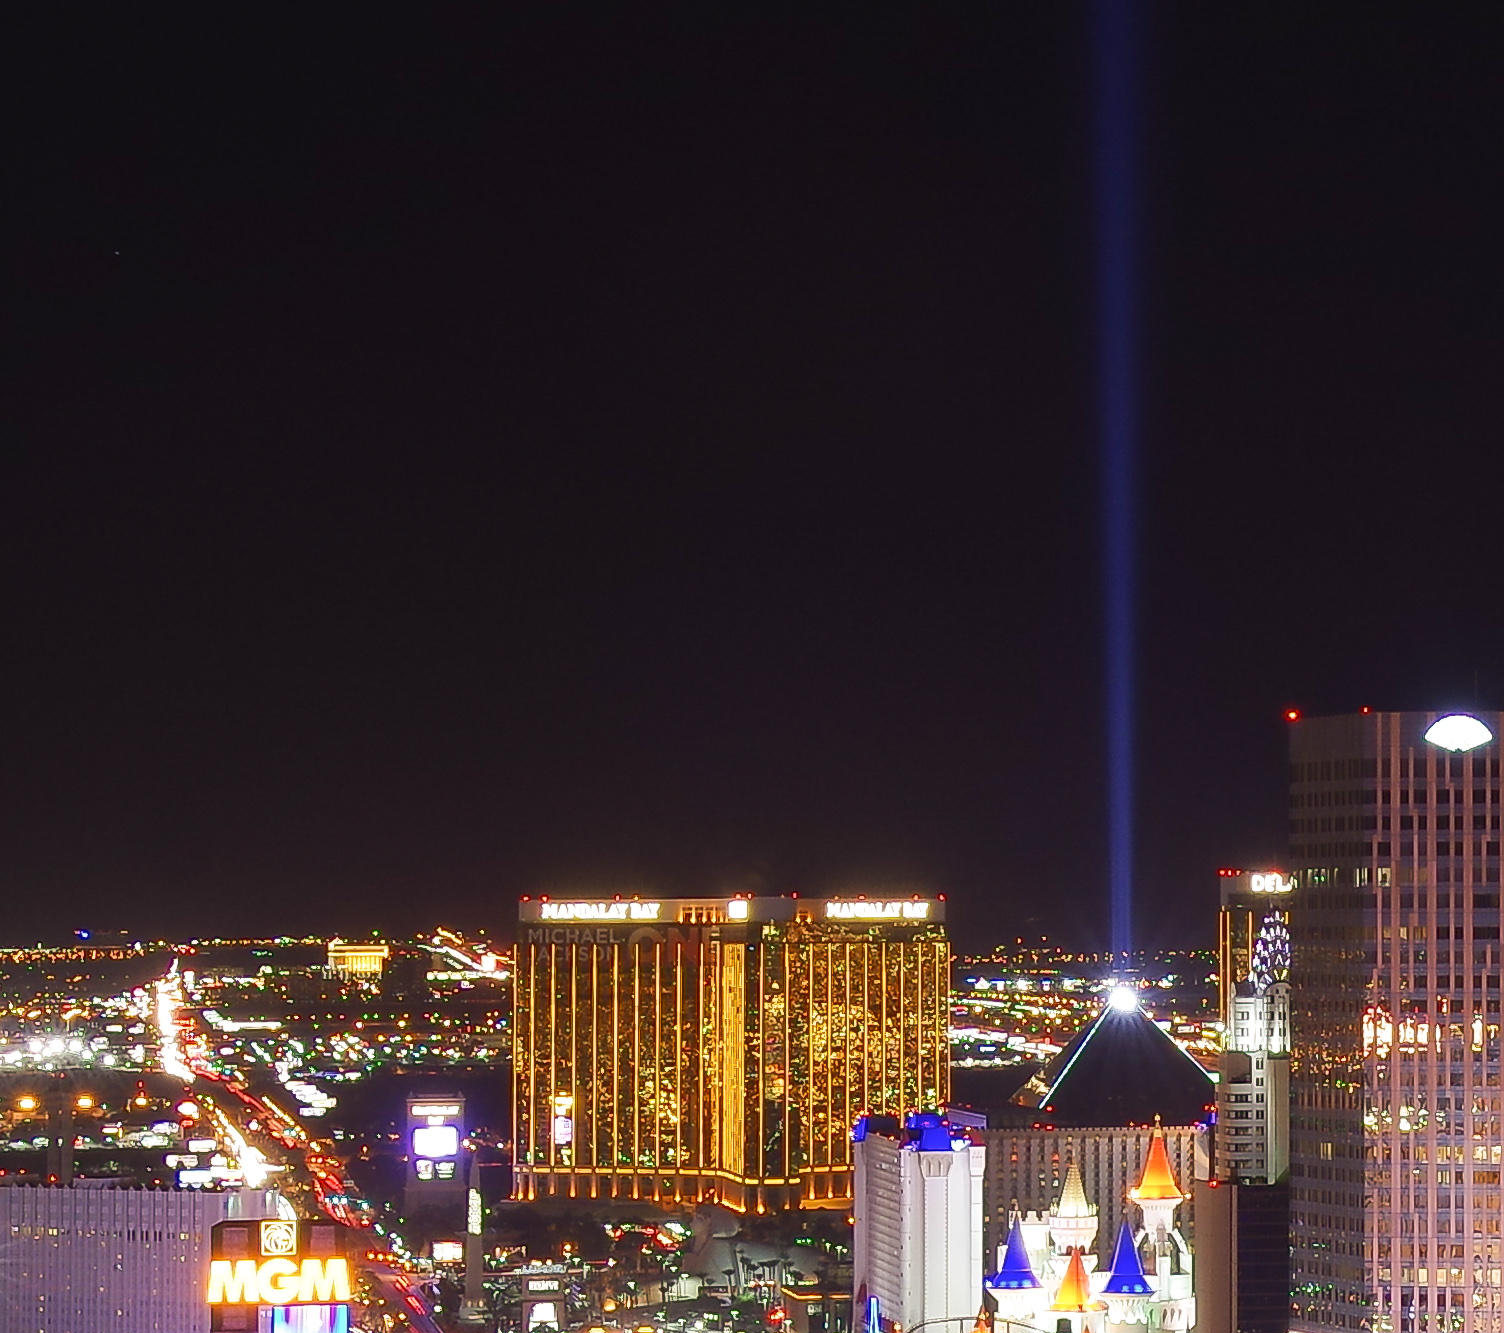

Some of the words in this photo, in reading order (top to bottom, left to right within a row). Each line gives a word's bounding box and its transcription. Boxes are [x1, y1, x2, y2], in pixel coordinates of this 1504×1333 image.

[630, 903, 661, 919] BAY
[528, 928, 620, 944] MICHAEL
[207, 1258, 351, 1303] MGM
